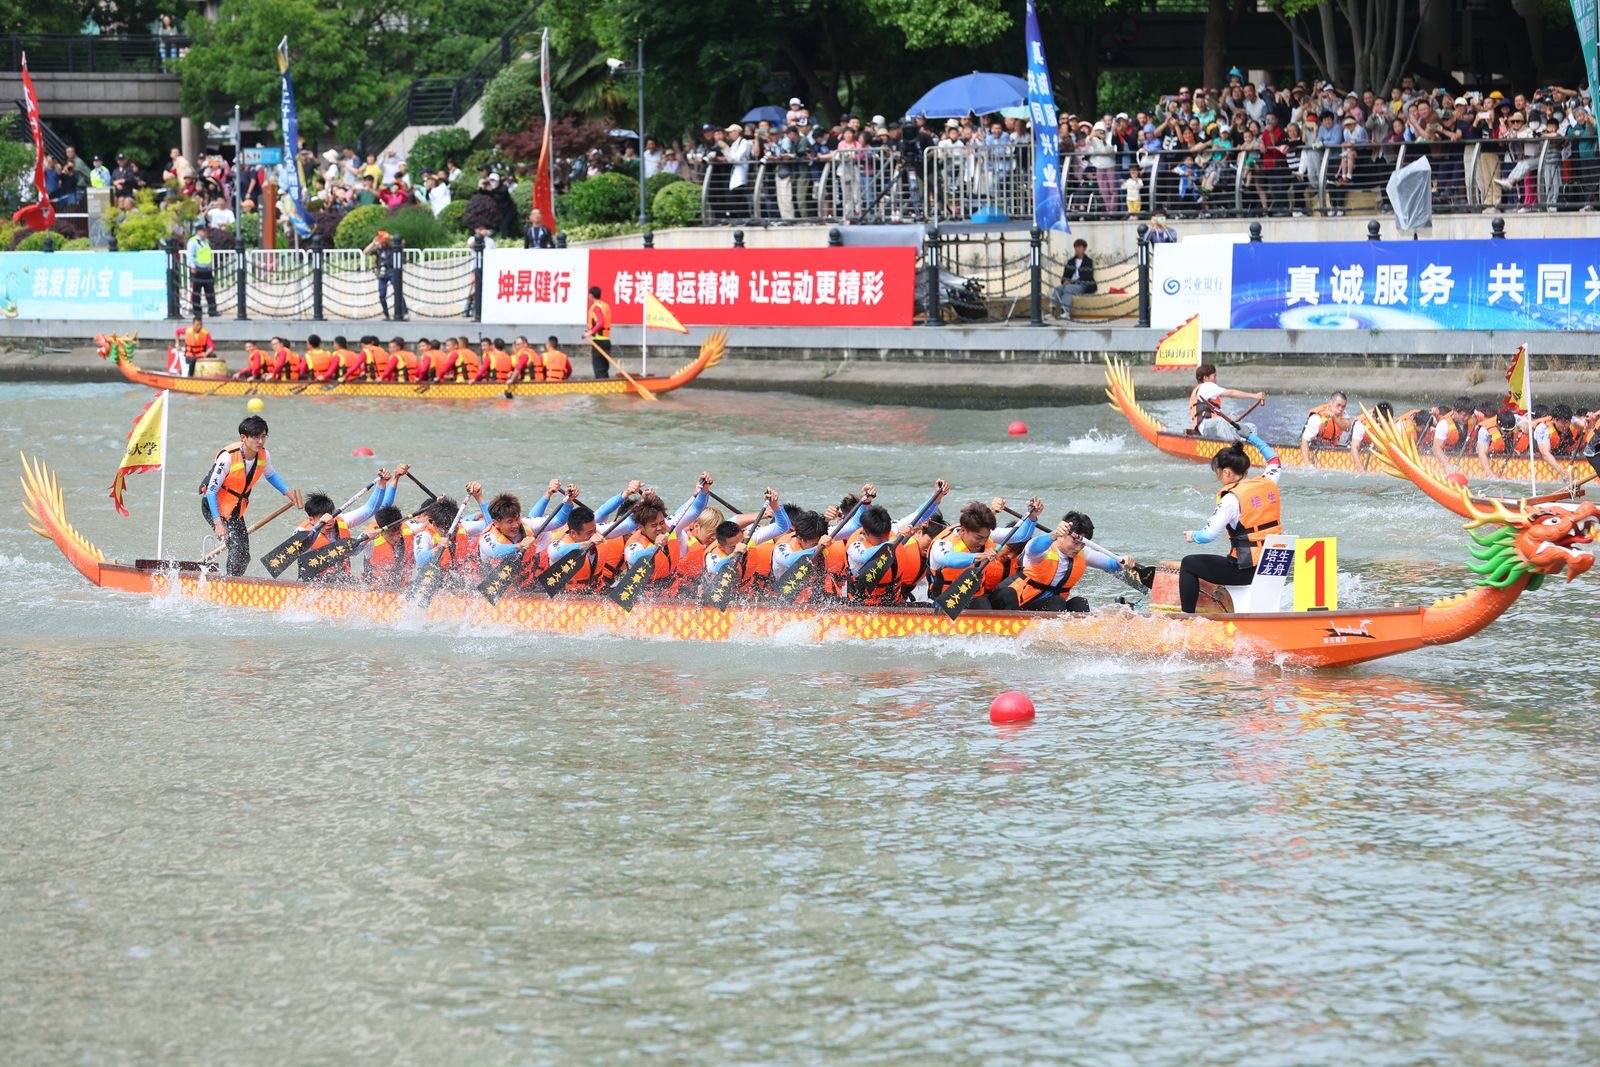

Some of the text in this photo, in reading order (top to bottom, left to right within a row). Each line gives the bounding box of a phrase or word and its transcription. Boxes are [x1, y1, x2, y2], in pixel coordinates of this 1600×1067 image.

[497, 269, 572, 303] 坤昇健行
[613, 269, 884, 306] 传递奥运精神 让运动更精彩
[1286, 262, 1455, 305] 真诚服务
[168, 348, 179, 374] 2
[1260, 562, 1286, 576] 龙舟
[1265, 550, 1290, 563] 培生
[1305, 540, 1326, 607] 1
